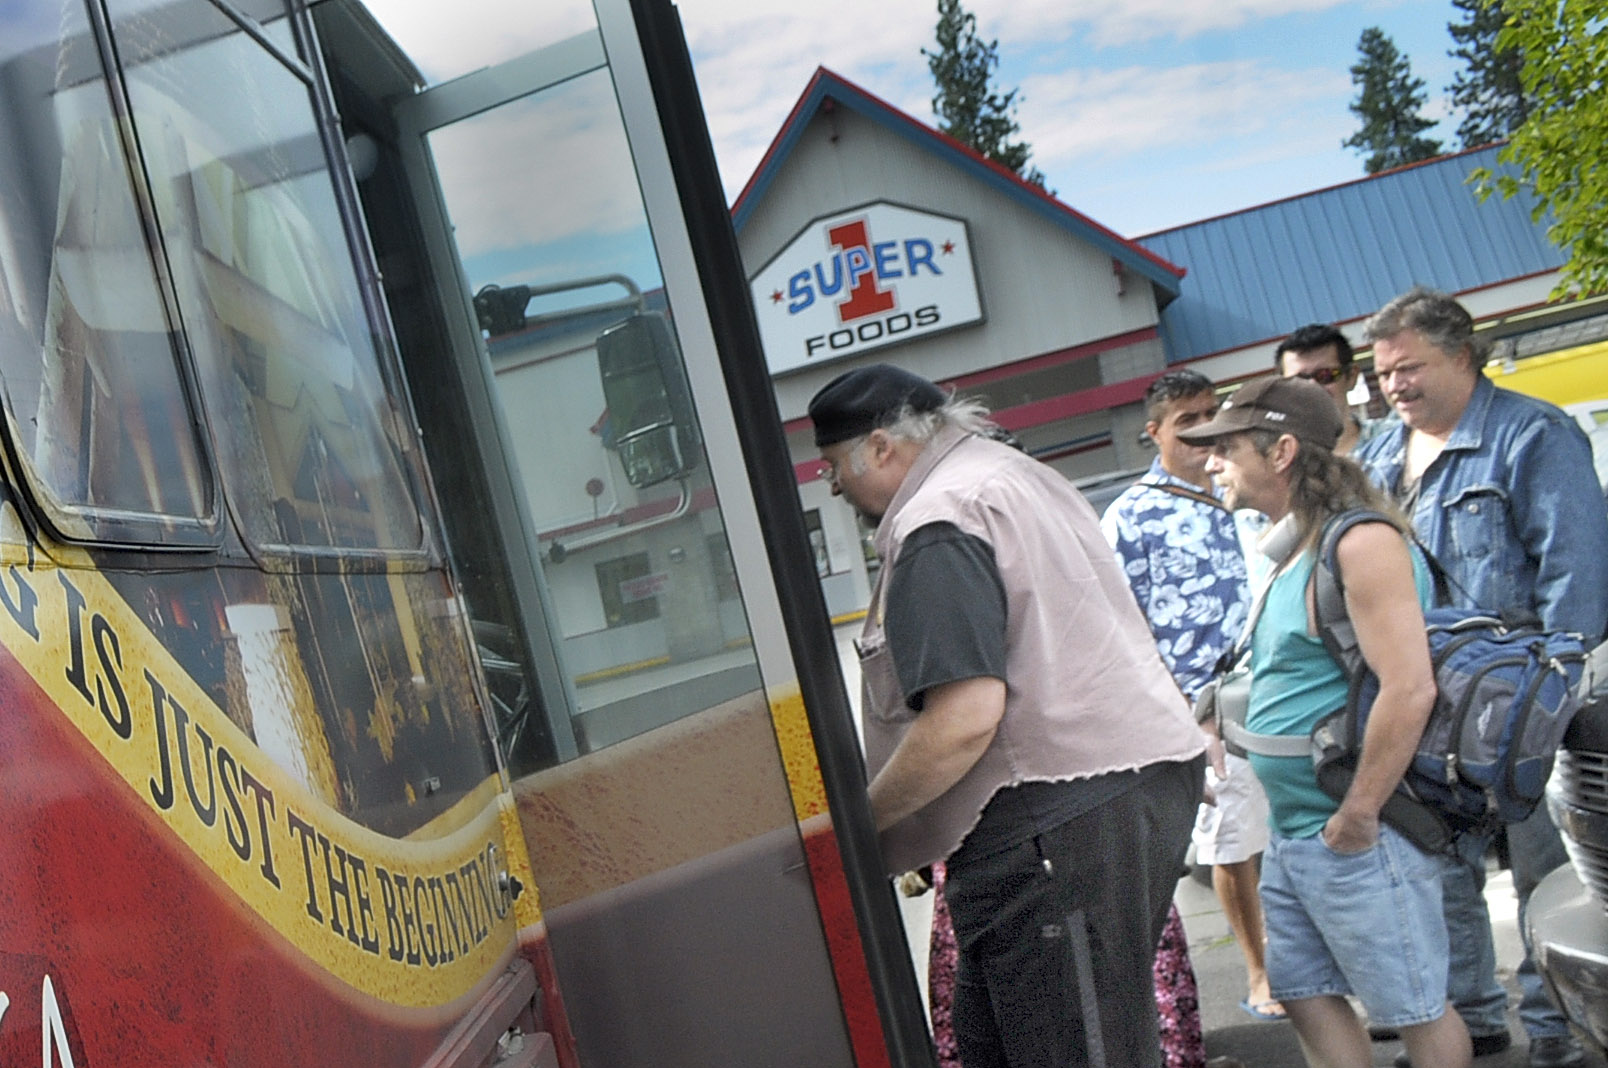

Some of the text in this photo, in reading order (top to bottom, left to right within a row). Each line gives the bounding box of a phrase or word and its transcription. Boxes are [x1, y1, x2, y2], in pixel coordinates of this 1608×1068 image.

[788, 237, 943, 315] SUPER
[806, 304, 940, 357] FOODS
[58, 569, 133, 740] IS
[143, 667, 281, 891] JUST
[287, 808, 380, 955] THE
[375, 841, 512, 968] BEGINNING
